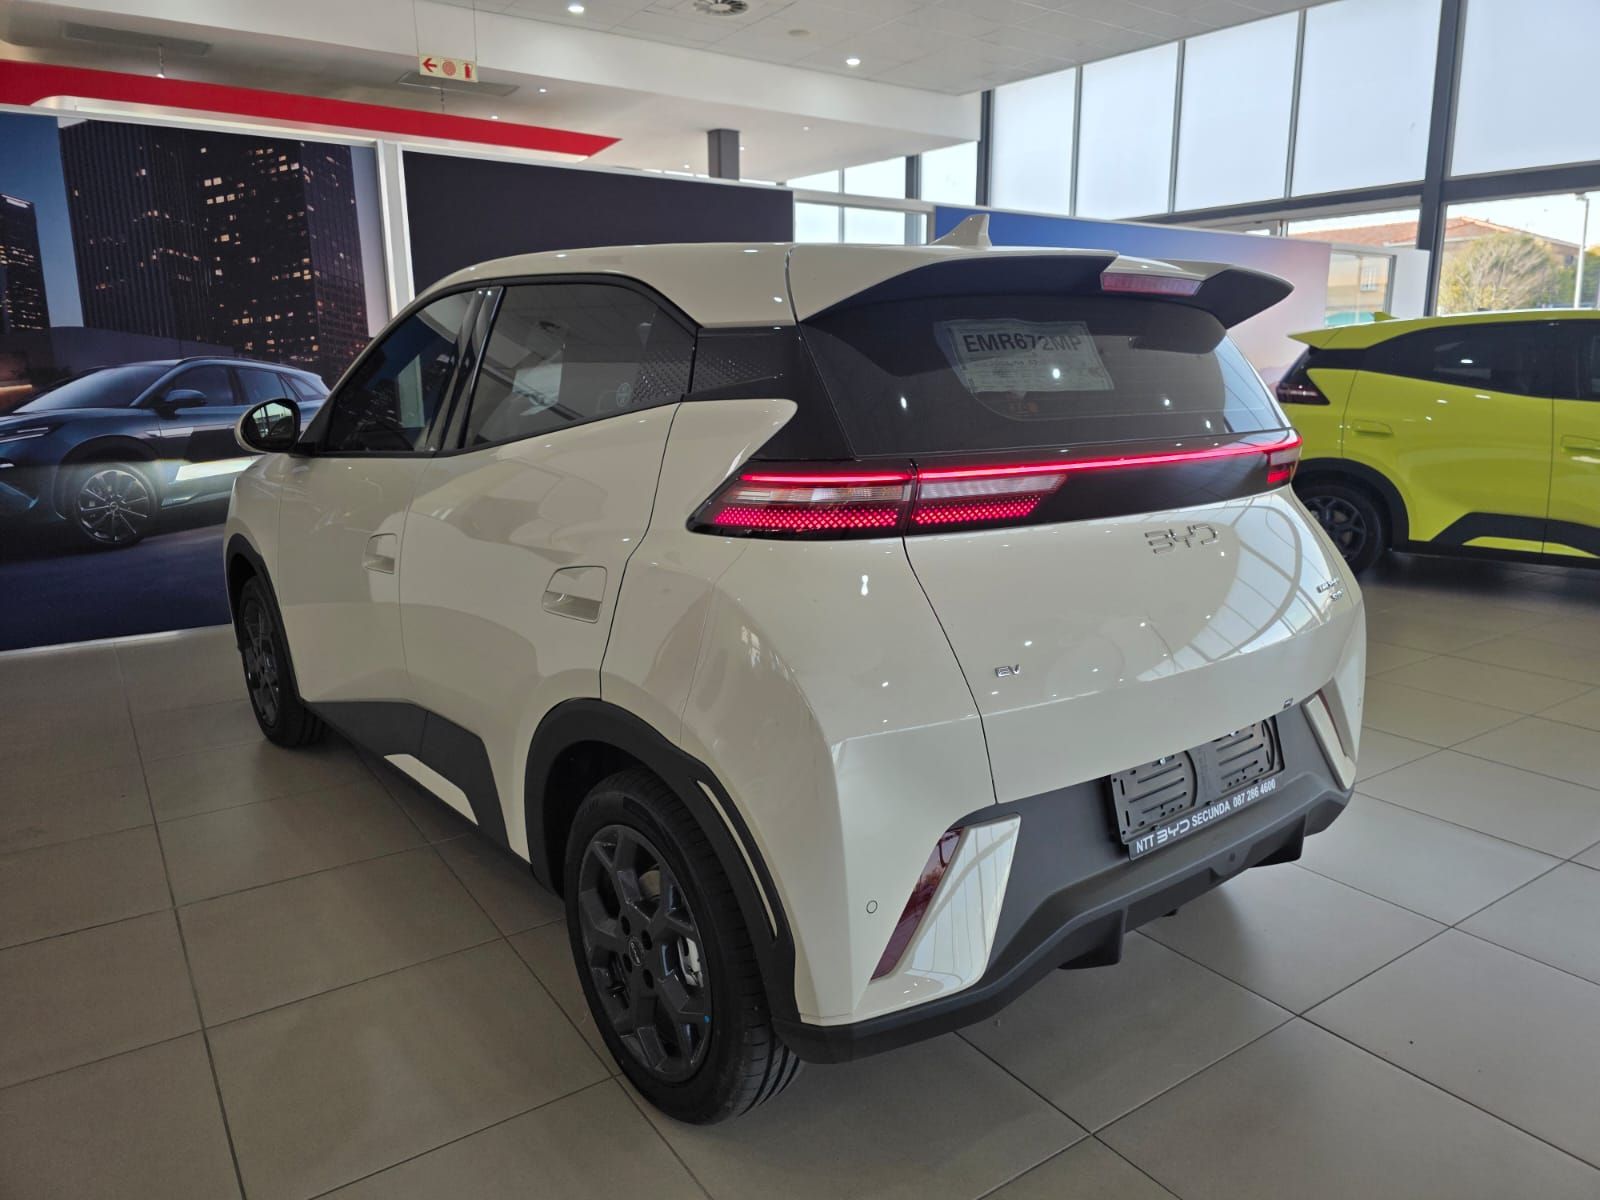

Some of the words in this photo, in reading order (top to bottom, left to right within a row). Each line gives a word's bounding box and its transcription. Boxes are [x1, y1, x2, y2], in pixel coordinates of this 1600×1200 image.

[963, 333, 1082, 352] EMR672MP
[1144, 523, 1218, 554] BYD
[995, 664, 1020, 678] EV
[1136, 834, 1155, 854] NTT
[1157, 818, 1190, 844] BYD
[1191, 801, 1231, 827] SECUNDA
[1233, 793, 1245, 808] 087
[1247, 786, 1259, 801] 286
